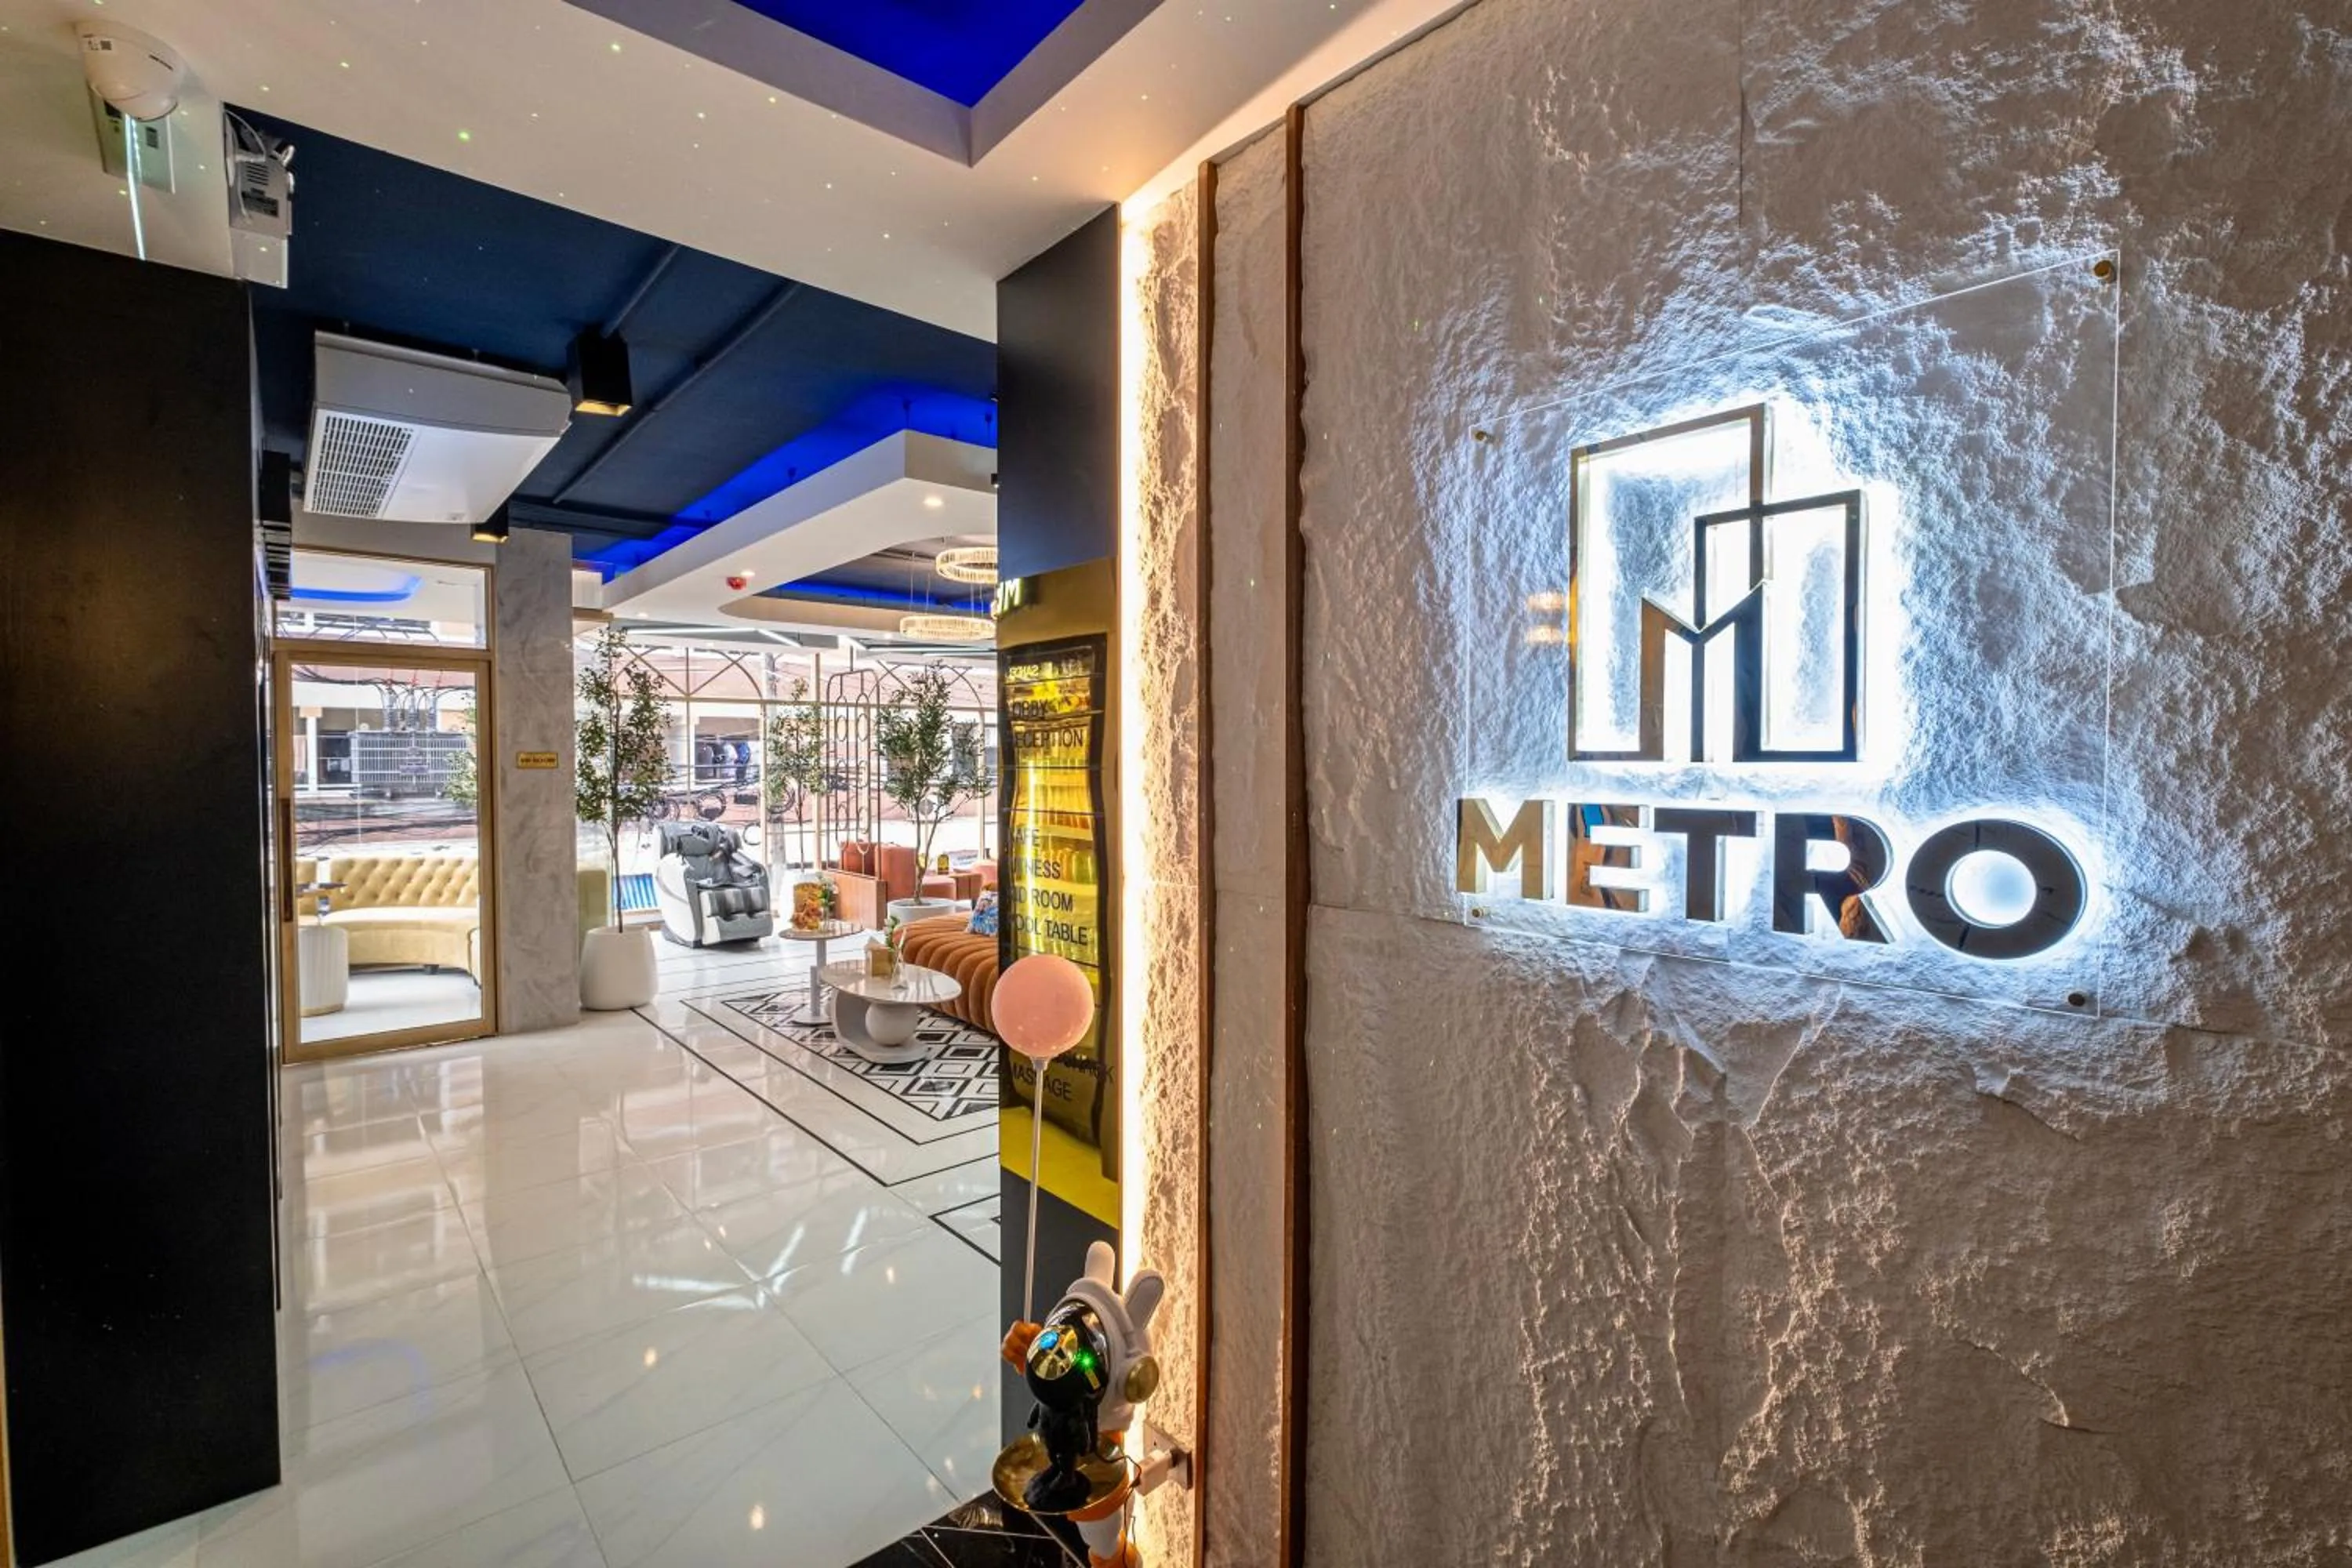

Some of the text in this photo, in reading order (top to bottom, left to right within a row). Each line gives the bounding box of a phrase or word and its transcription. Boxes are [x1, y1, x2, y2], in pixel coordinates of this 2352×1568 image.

[1012, 728, 1083, 748] ECEPTION
[1455, 797, 2087, 960] METRO
[1031, 887, 1074, 913] ROOM
[1012, 913, 1088, 946] OOL TABLE
[1014, 1062, 1072, 1102] MASAGE
